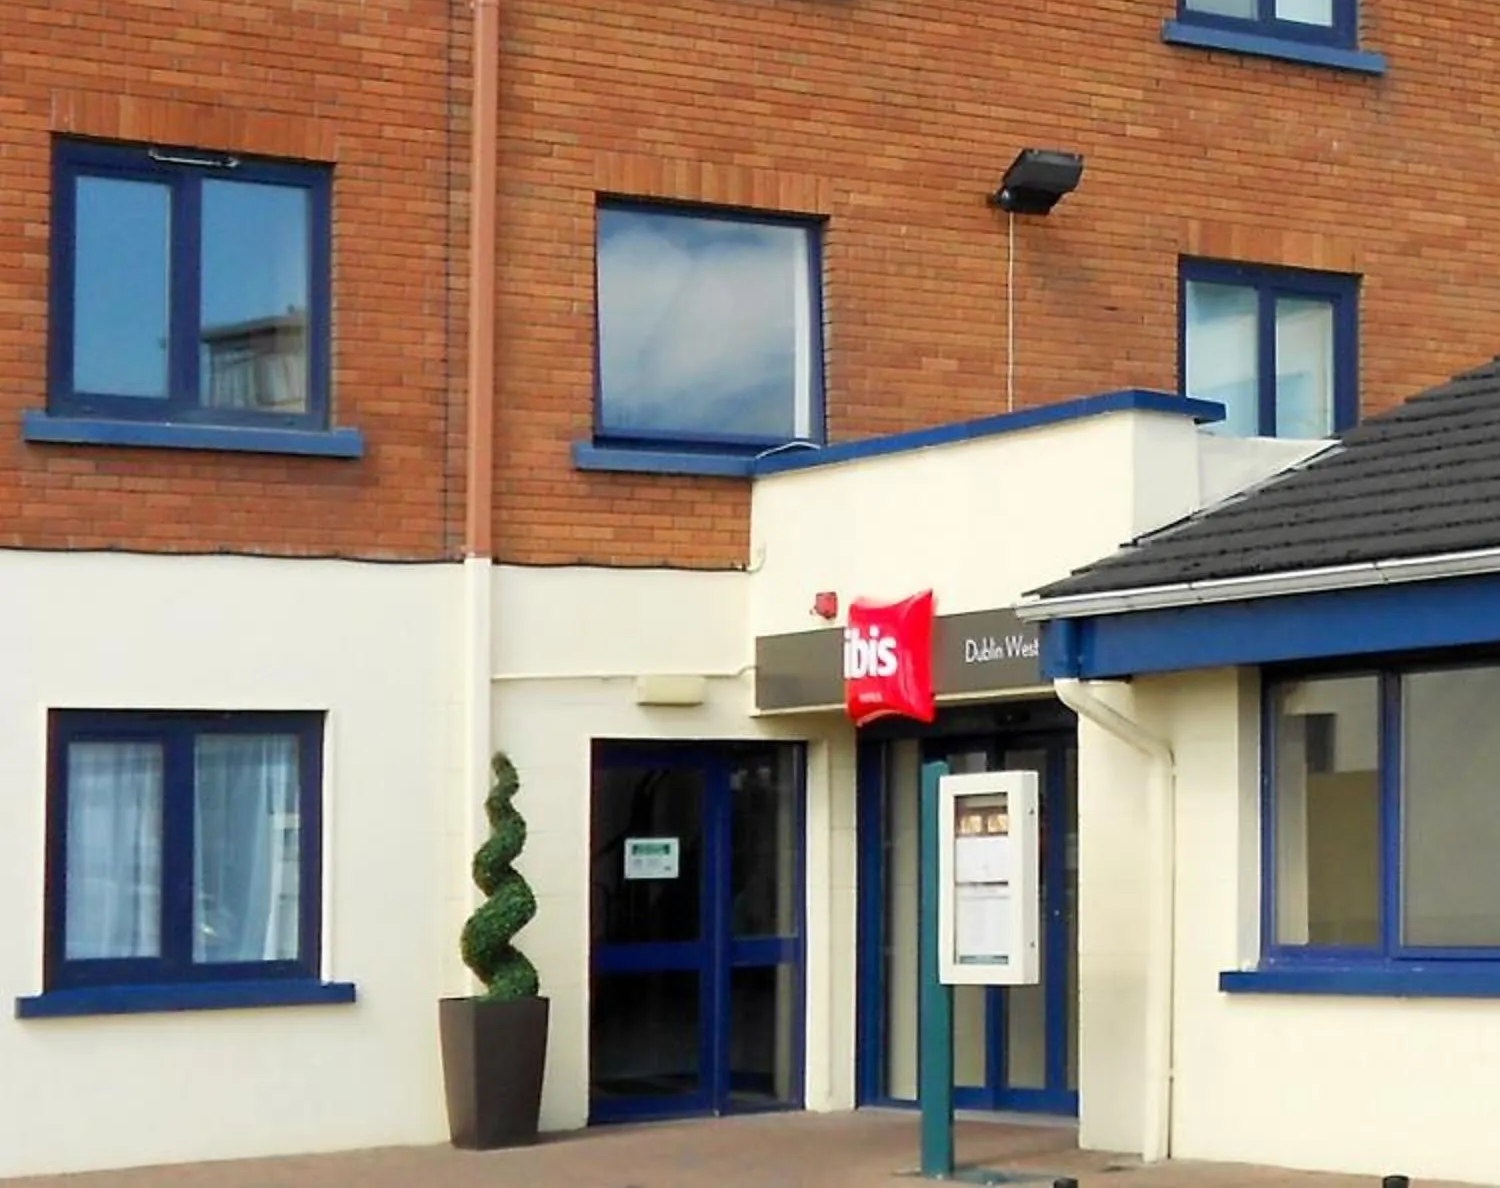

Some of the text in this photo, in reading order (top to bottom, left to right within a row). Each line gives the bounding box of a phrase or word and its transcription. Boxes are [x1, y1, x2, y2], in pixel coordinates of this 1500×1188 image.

[844, 624, 898, 679] ibis
[965, 634, 1039, 663] Dublin West
